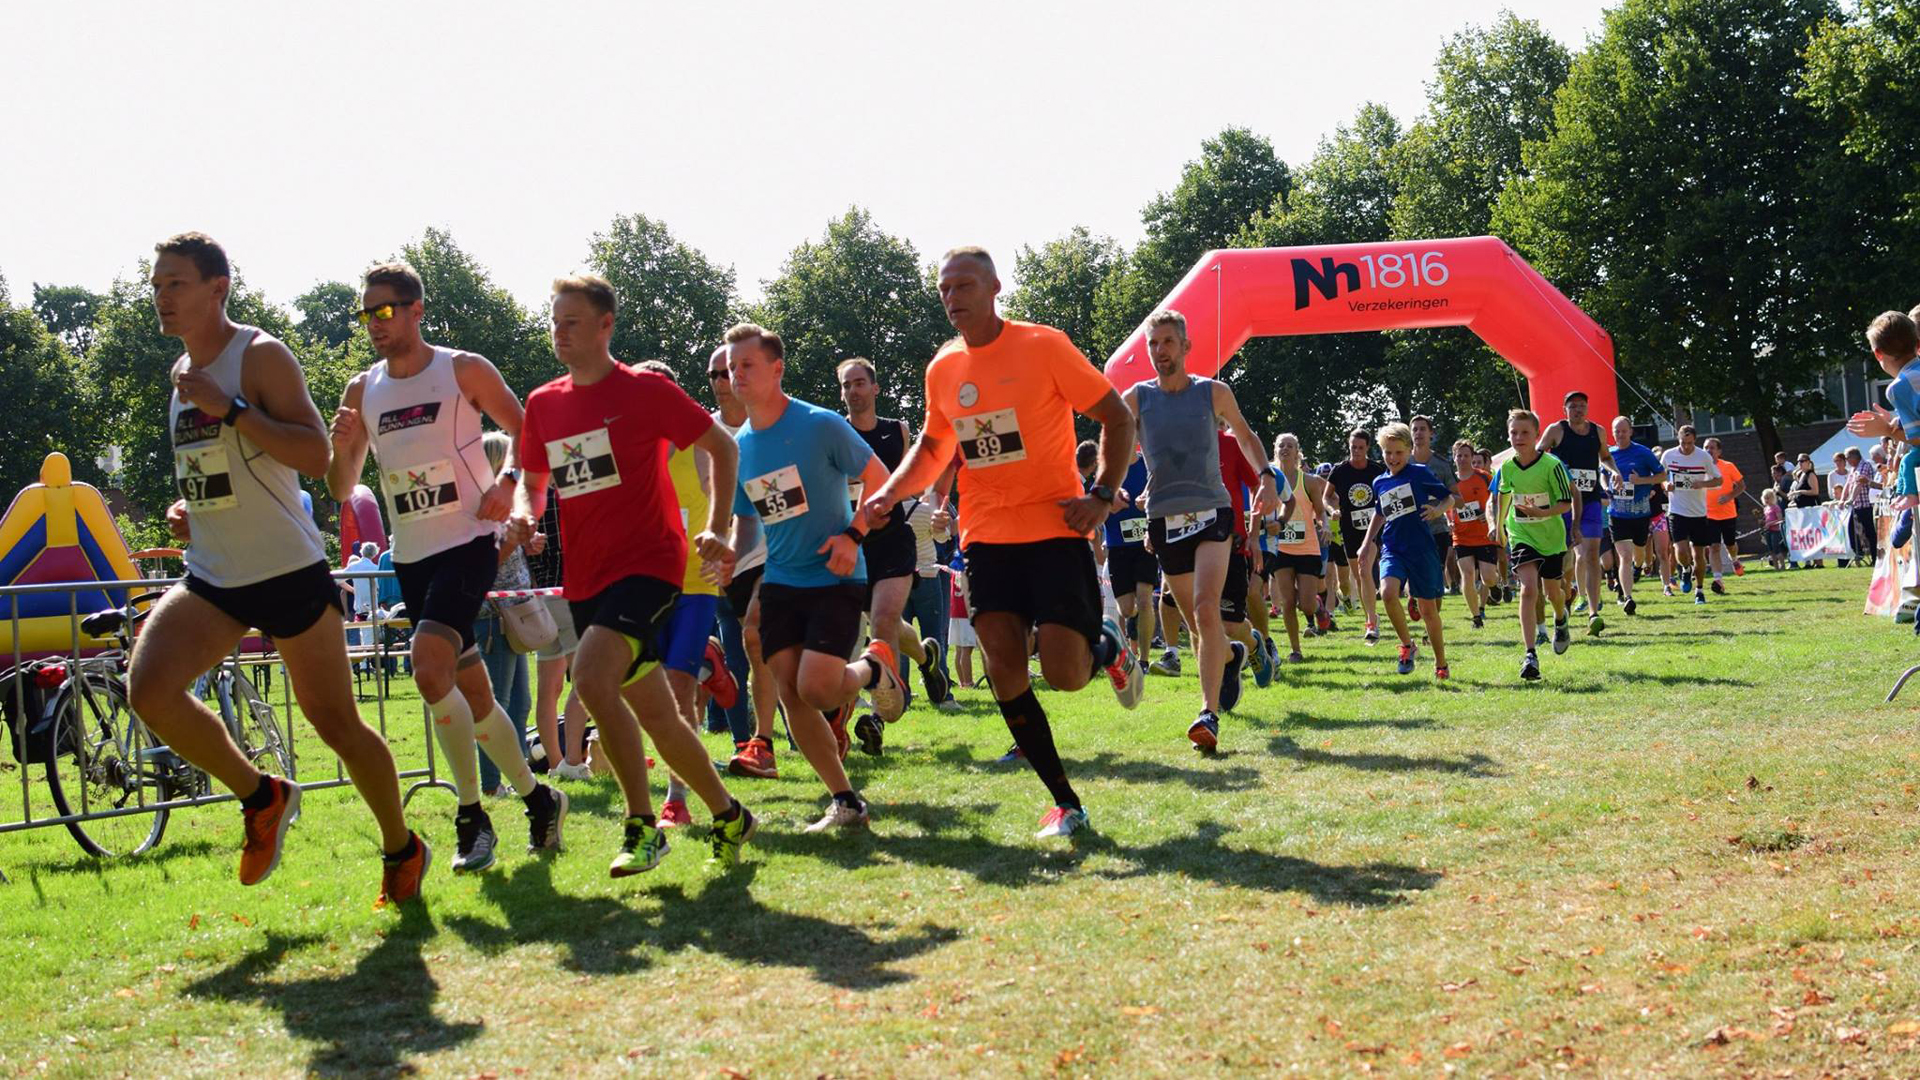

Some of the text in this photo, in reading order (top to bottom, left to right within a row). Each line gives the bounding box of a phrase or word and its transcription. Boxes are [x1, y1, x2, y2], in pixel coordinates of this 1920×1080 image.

[1348, 298, 1449, 312] Verzekeringen
[976, 436, 1001, 458] 89
[565, 460, 593, 485] 44
[186, 477, 207, 500] 97
[404, 486, 441, 511] 107
[765, 493, 788, 514] 55
[1390, 500, 1404, 514] 35
[1462, 509, 1477, 519] 133
[1131, 526, 1145, 538] 88
[1284, 530, 1297, 540] 90
[1790, 527, 1822, 551] ERGO
